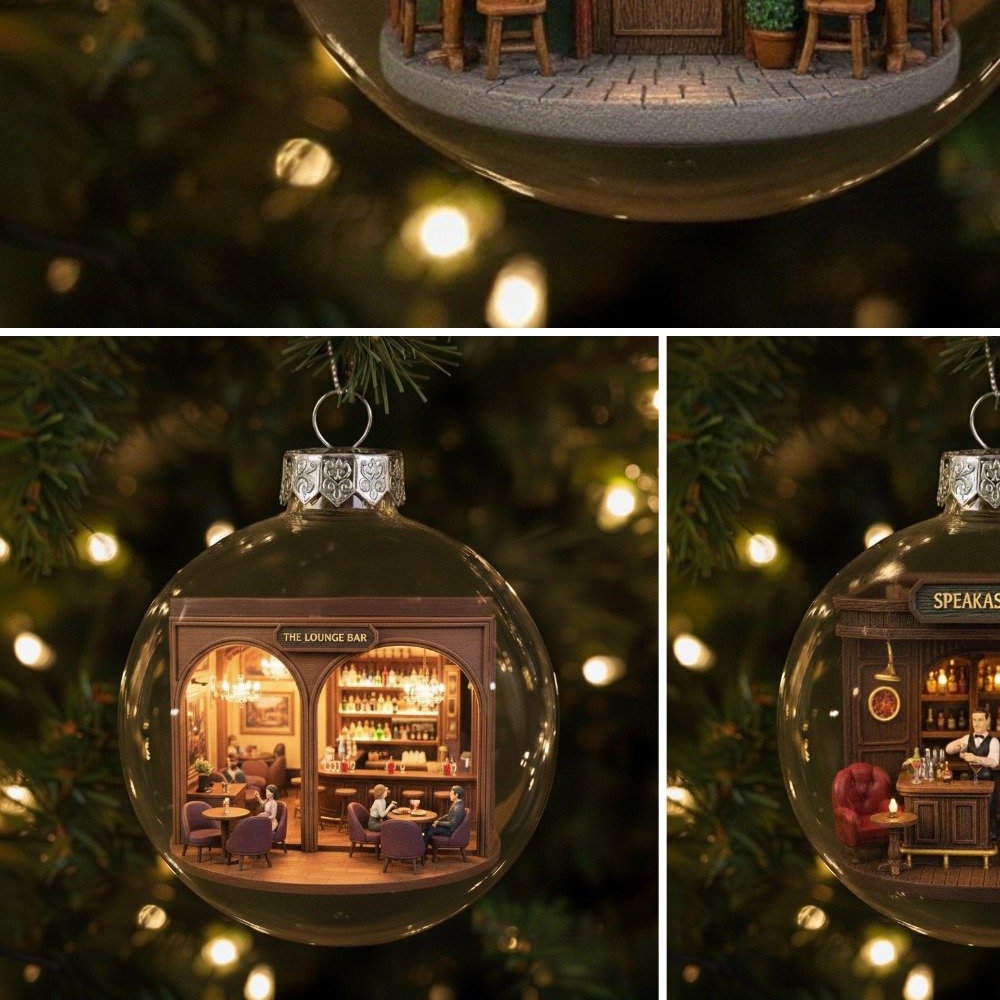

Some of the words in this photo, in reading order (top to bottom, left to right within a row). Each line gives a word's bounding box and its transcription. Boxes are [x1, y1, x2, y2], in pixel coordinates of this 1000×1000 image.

[283, 632, 302, 642] THE
[304, 633, 344, 642] LOUNGE
[347, 633, 367, 642] BAR
